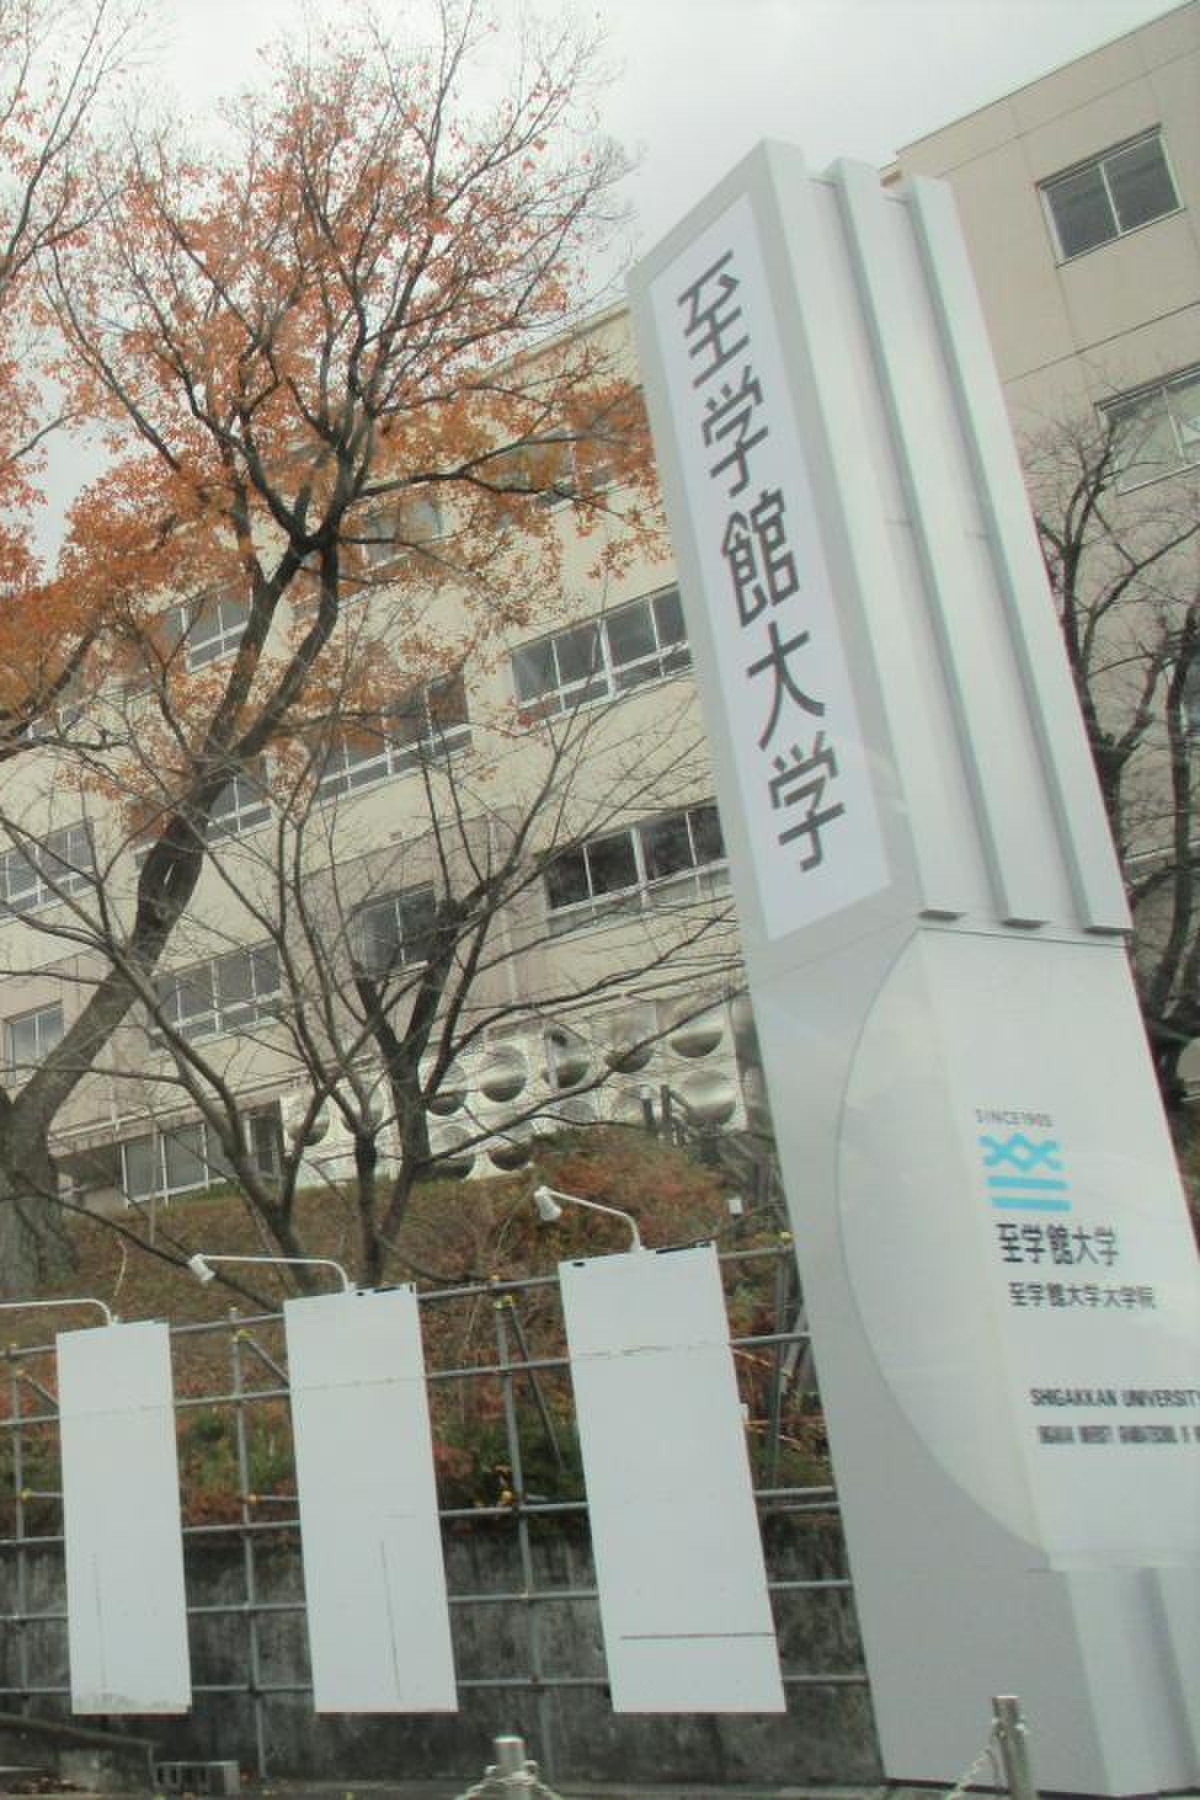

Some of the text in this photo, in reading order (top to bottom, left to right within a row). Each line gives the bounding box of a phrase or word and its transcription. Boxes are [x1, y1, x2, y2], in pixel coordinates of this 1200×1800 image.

[676, 251, 845, 871] 至学館大学
[996, 1223, 1119, 1266] 至学館大学
[1029, 1388, 1117, 1407] SHIGAKKAN
